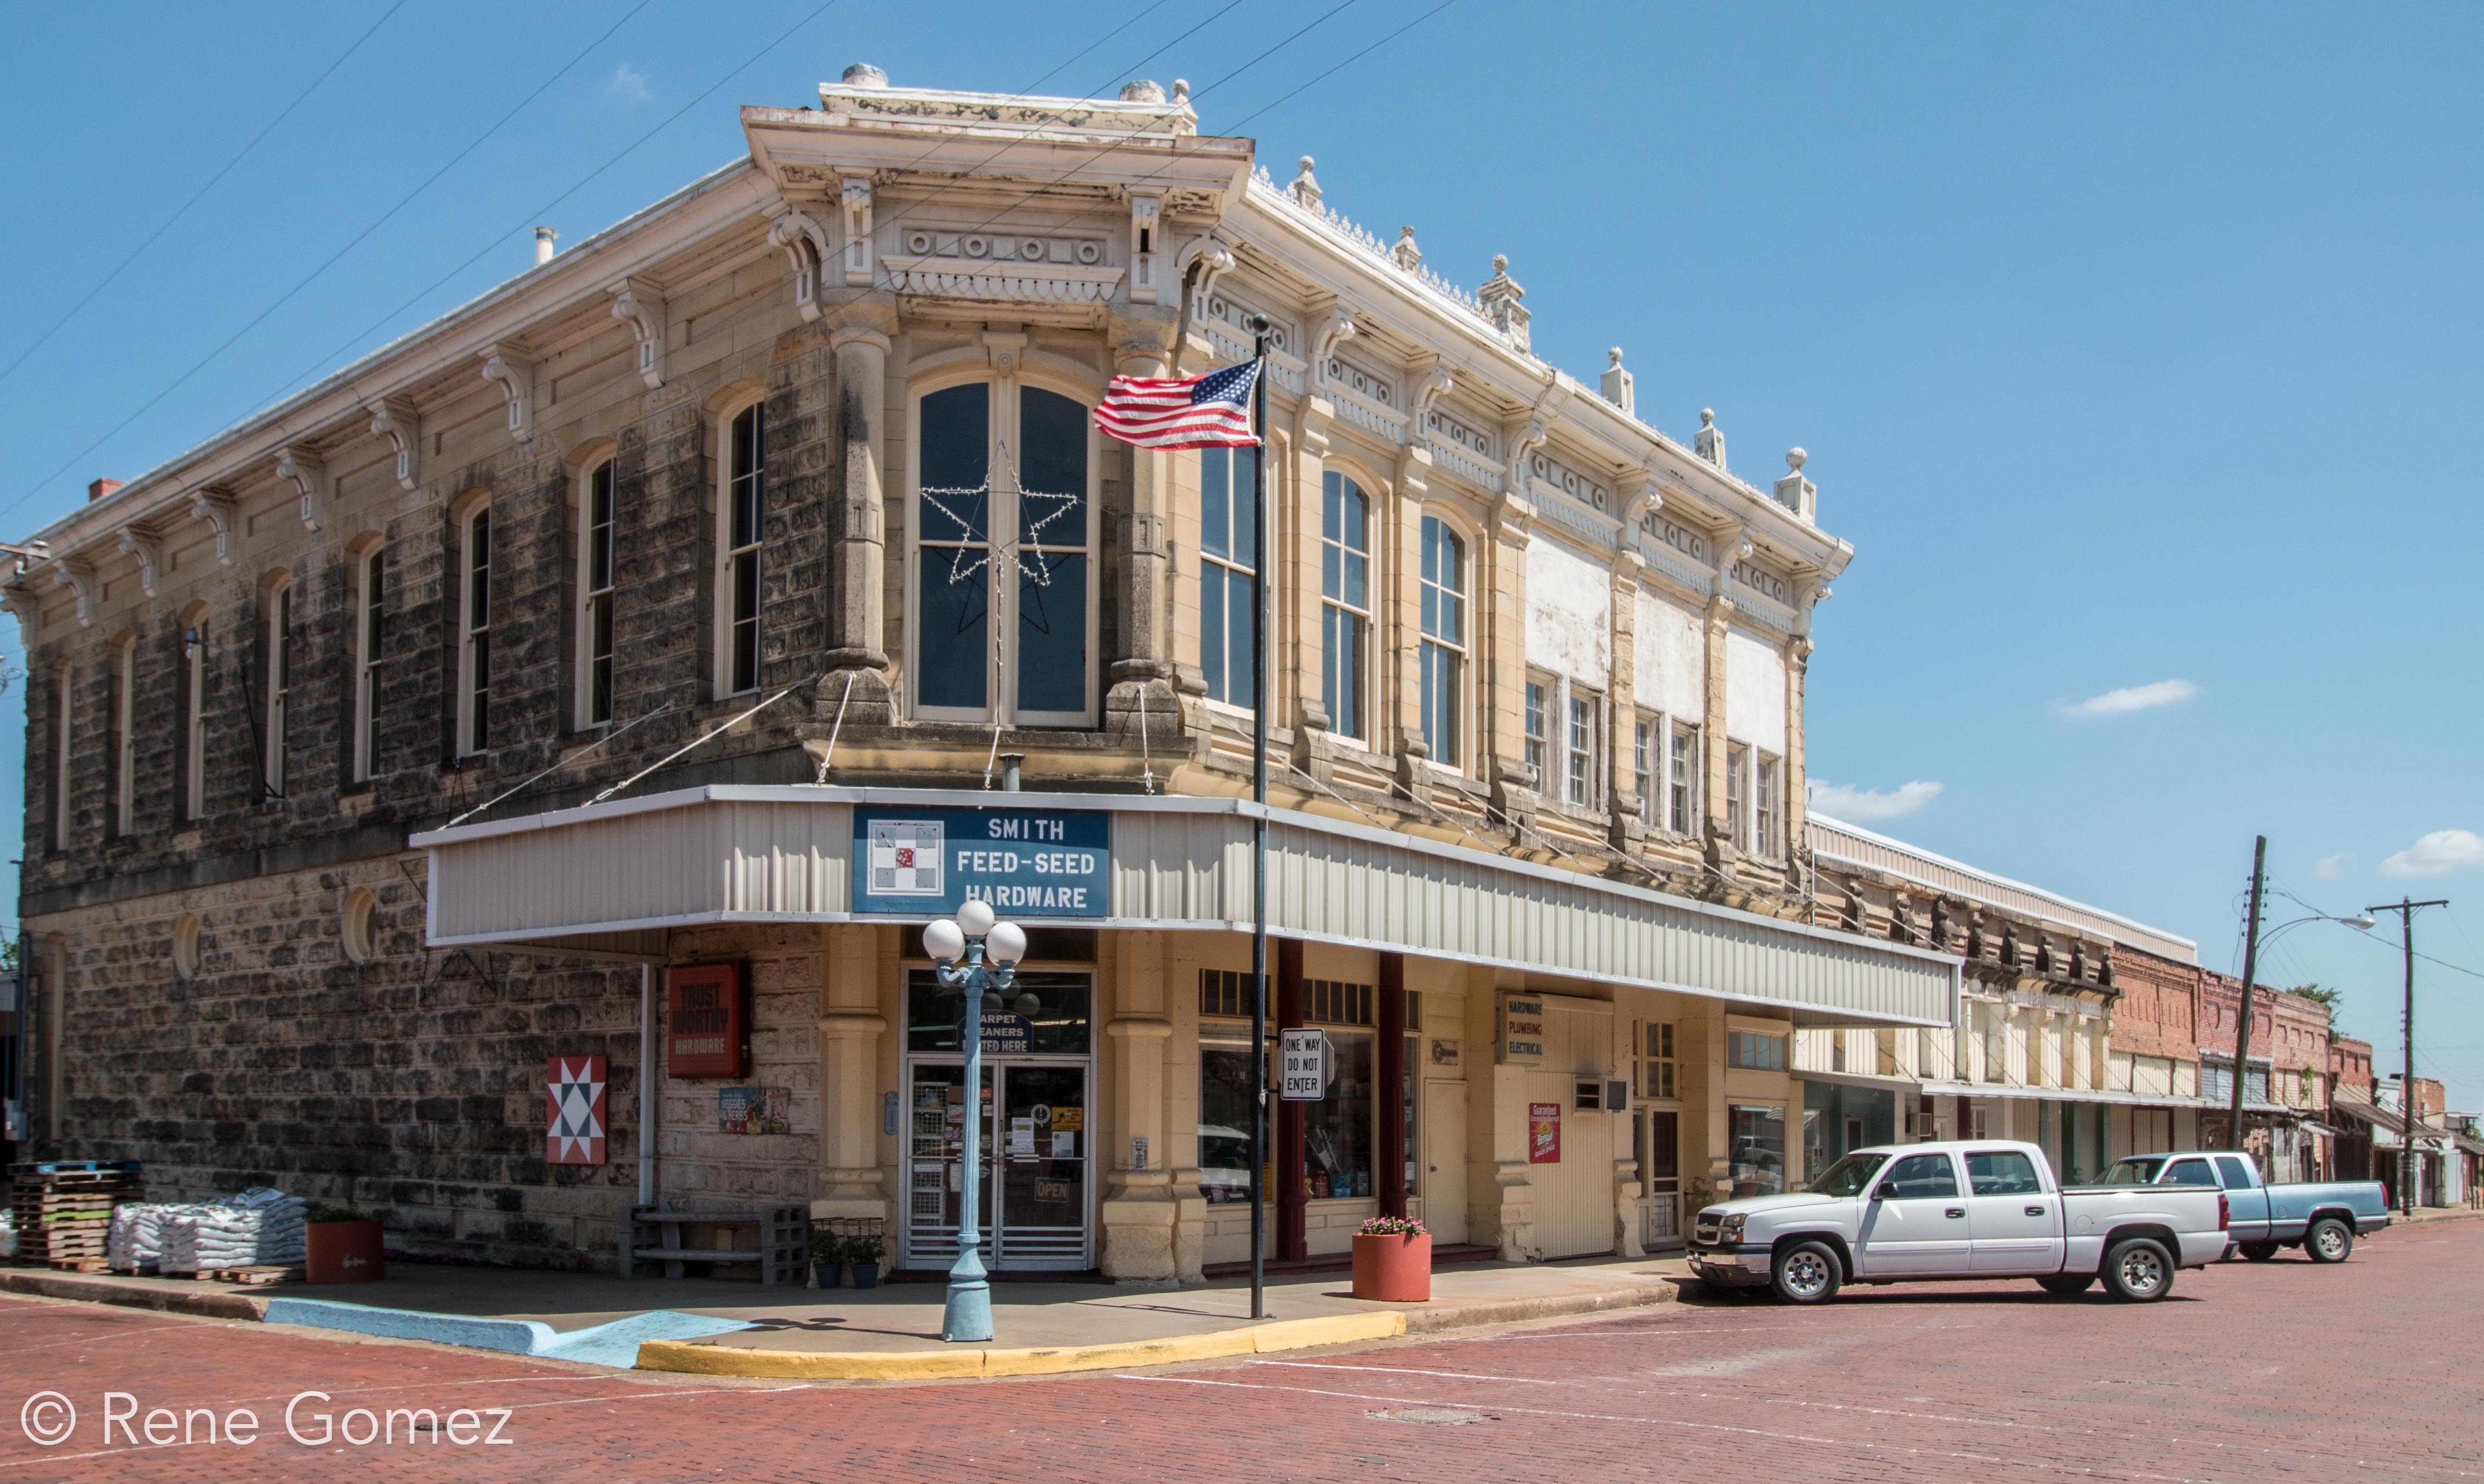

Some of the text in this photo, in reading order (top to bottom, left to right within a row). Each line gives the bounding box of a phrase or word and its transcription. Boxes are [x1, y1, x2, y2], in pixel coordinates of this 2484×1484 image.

[988, 819, 1064, 840] SMITH
[958, 851, 1095, 874] FEED-SEED
[965, 885, 1087, 909] HARDWARE
[680, 982, 721, 1009] TRUST
[1508, 1000, 1542, 1016] HARDWARE
[672, 1008, 729, 1034] WORTHY
[979, 1014, 1016, 1024] ARPET
[964, 1027, 1024, 1037] EANERS
[1508, 1020, 1543, 1035] PLUMBING
[675, 1038, 726, 1055] HARDWARE
[1001, 1040, 1028, 1052] HERE
[1285, 1038, 1321, 1052] ONE WAY
[1508, 1040, 1543, 1056] ELECTRICAL
[1288, 1058, 1319, 1070] DO NOT
[1287, 1077, 1318, 1090] ENTER
[720, 1099, 746, 1109] VEGGIES
[728, 1110, 748, 1121] HERBS
[1537, 1128, 1554, 1146] Bengal
[1037, 1182, 1067, 1198] OPEN
